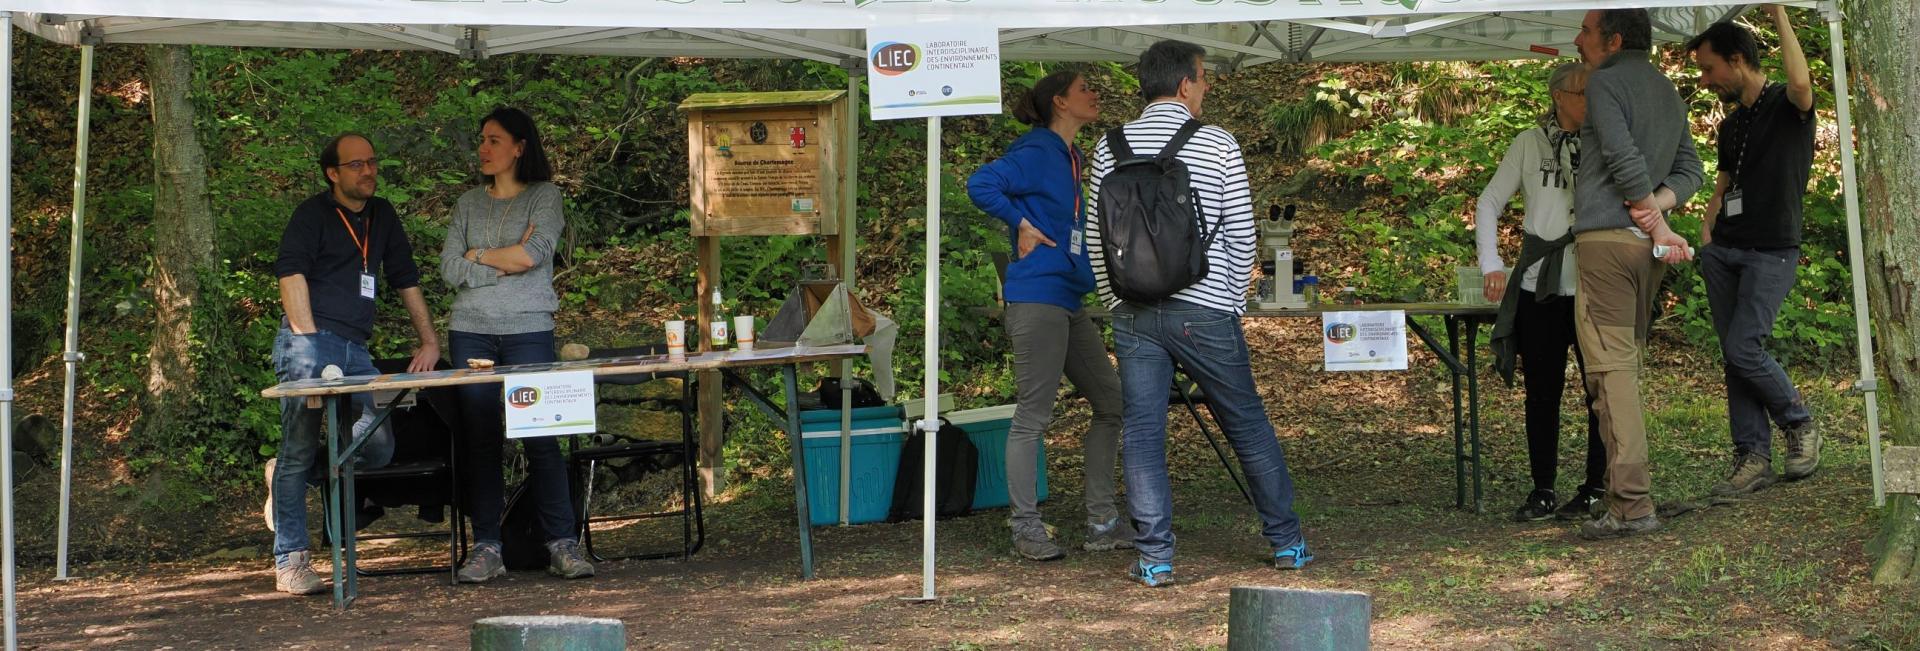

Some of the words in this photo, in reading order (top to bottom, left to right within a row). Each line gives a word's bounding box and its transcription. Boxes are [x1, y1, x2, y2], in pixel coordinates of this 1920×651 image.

[926, 40, 967, 49] LABORATOIRE
[926, 46, 989, 56] INTERDISCIPLINAIRE
[879, 49, 912, 67] LIEC
[926, 55, 939, 63] DES
[940, 53, 998, 63] ENVIRONNEMENTS
[926, 62, 975, 71] CONTINENTAUX
[512, 391, 535, 403] LIEC
